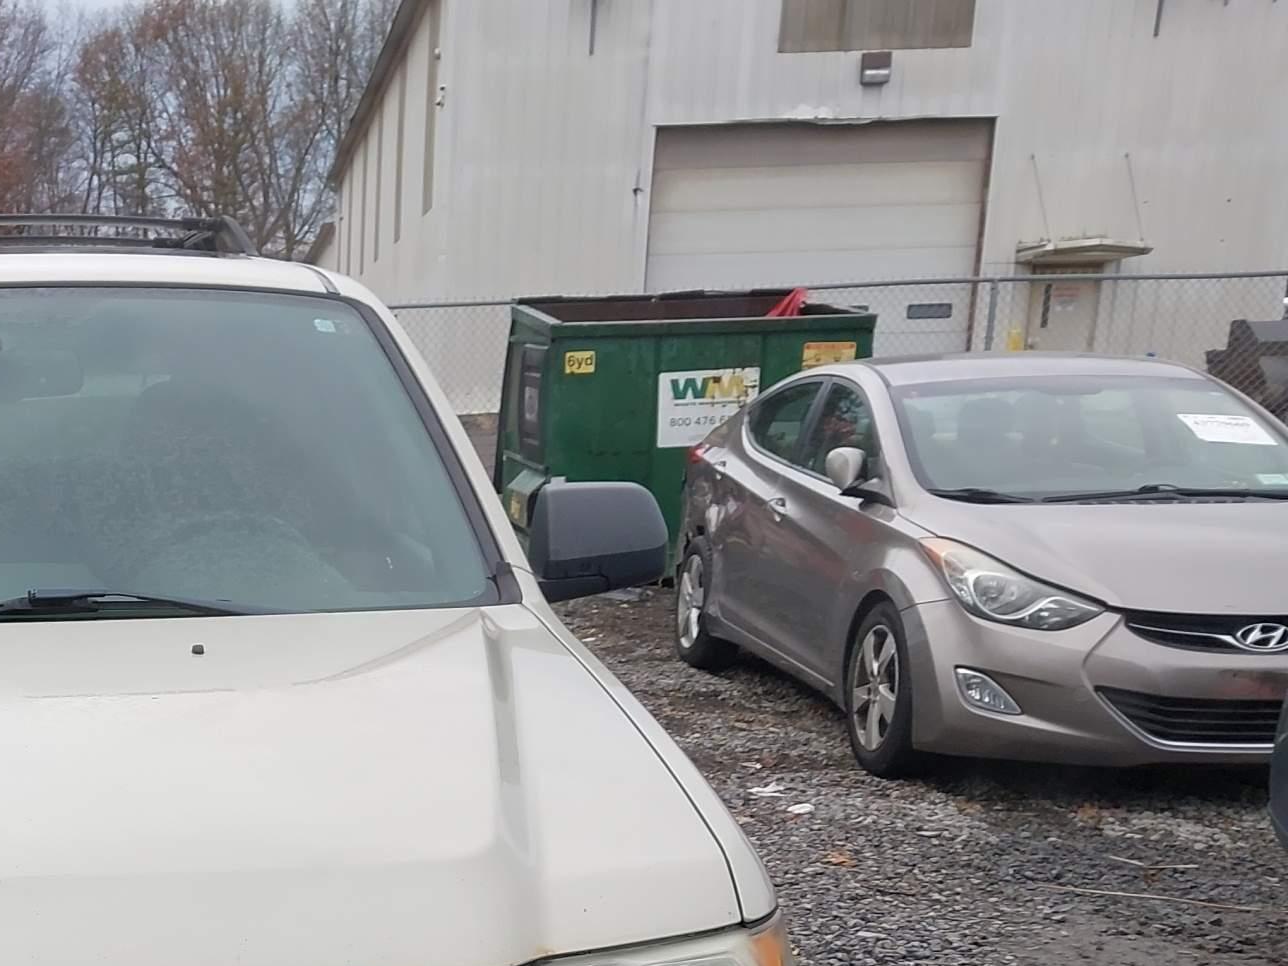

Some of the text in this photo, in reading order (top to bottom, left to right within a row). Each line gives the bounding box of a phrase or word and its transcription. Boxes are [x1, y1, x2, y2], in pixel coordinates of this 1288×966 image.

[567, 353, 594, 370] 6yd
[670, 375, 745, 400] WM
[669, 416, 692, 427] 800
[694, 415, 716, 426] 476
